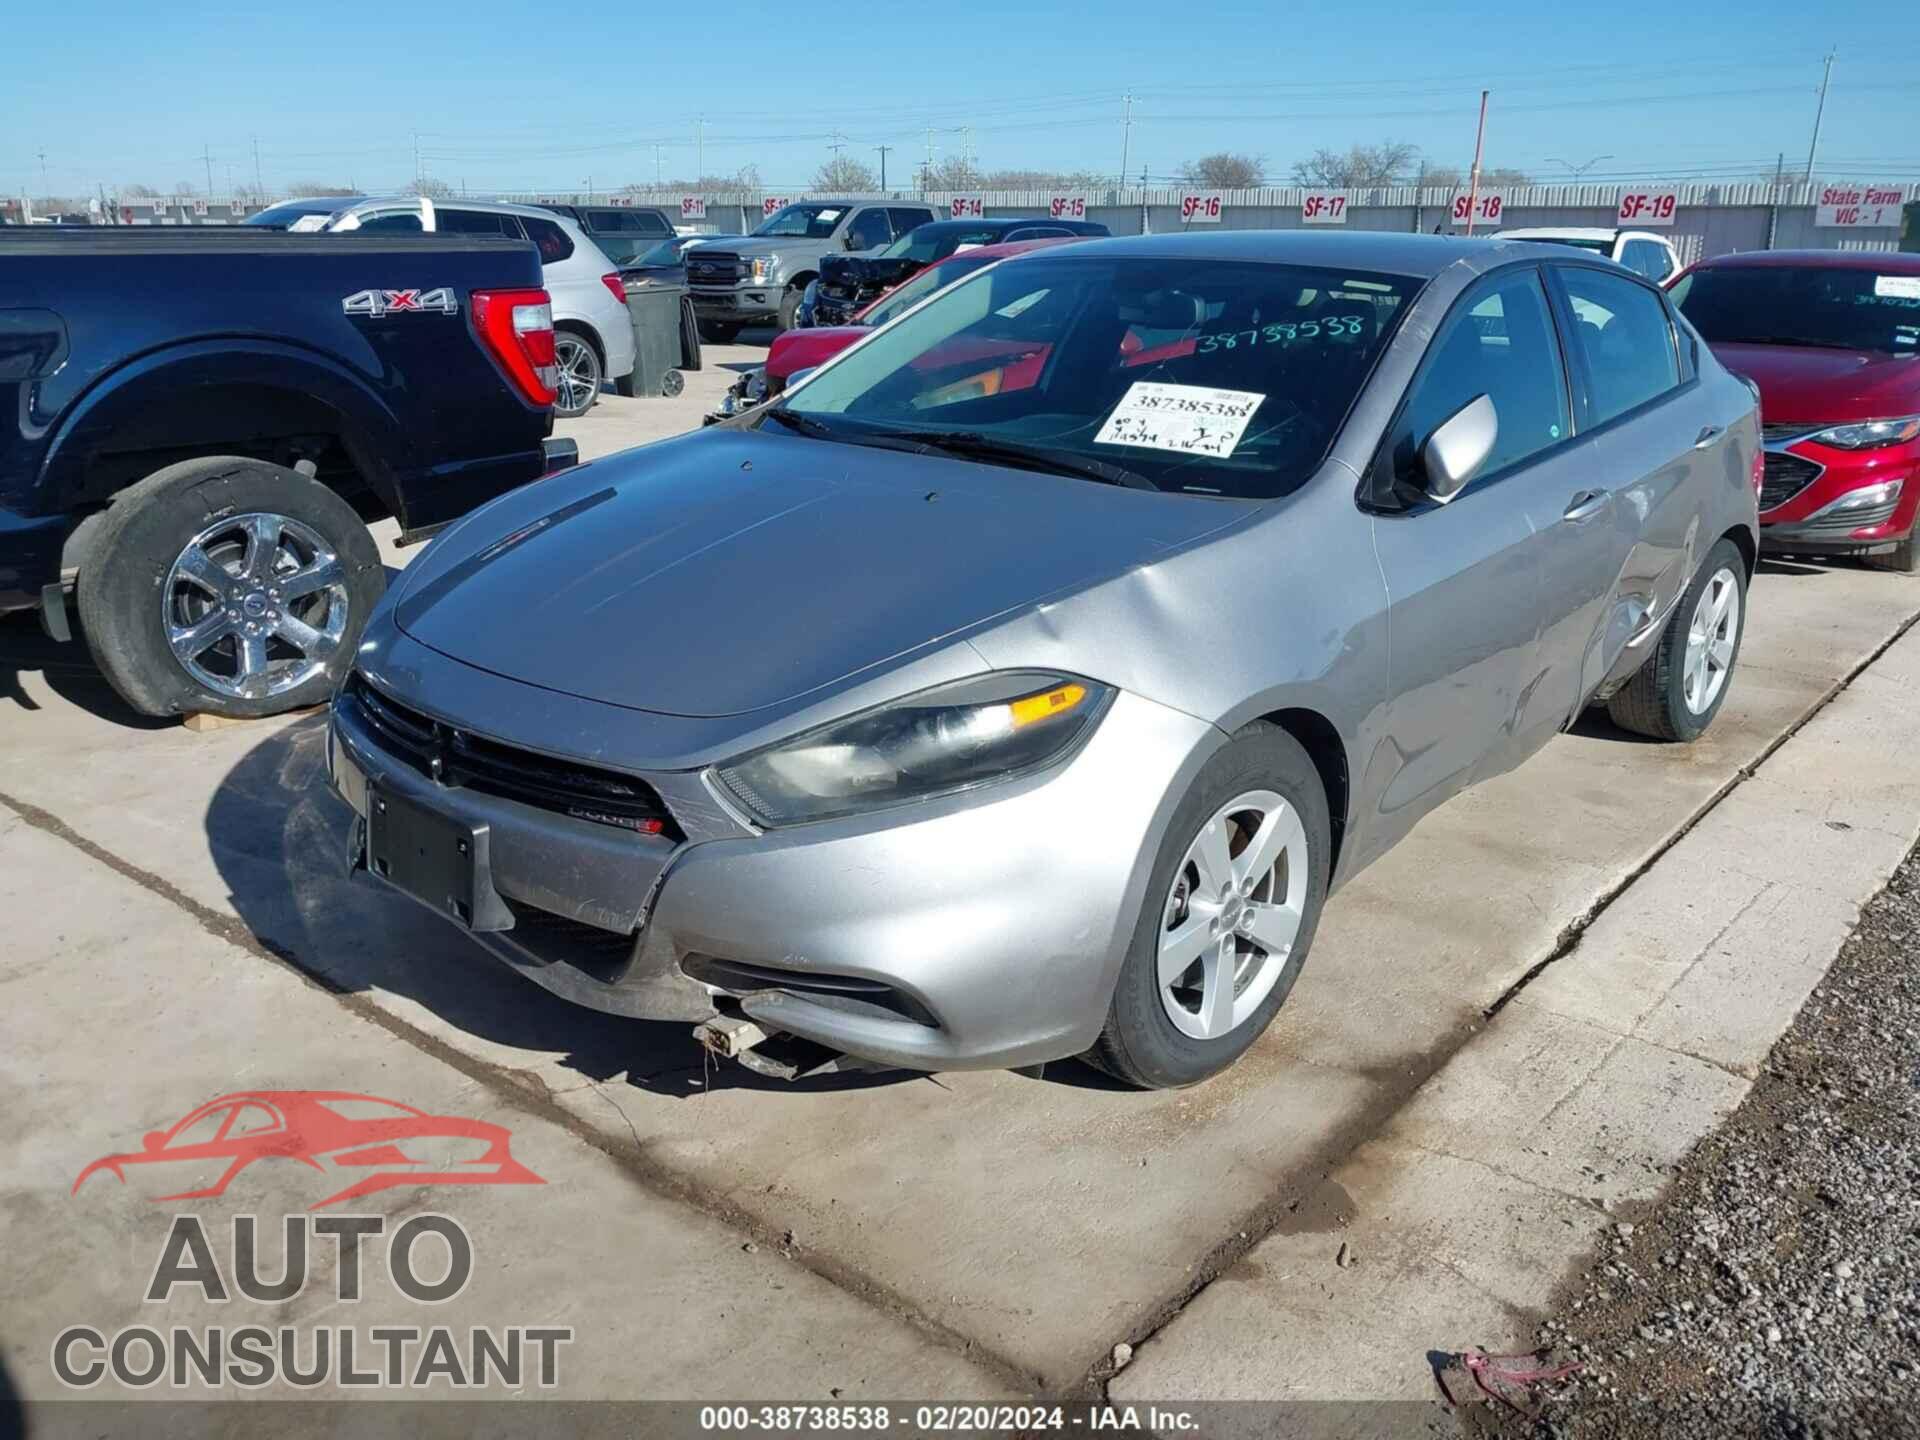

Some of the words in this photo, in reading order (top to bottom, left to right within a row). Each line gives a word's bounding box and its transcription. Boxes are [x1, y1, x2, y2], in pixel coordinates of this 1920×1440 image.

[1822, 189, 1860, 205] State
[1863, 188, 1902, 205] Farm
[682, 198, 704, 214] SF-11
[952, 199, 981, 216] SF-14
[1051, 198, 1084, 216] SF-15
[1182, 196, 1219, 216] SF-16
[1304, 197, 1345, 216] SF-17
[1454, 196, 1501, 217] SF-18
[1619, 195, 1675, 218] SF-19
[1835, 207, 1860, 224] VIC
[1874, 207, 1882, 224] 1
[1198, 315, 1364, 353] 38738538
